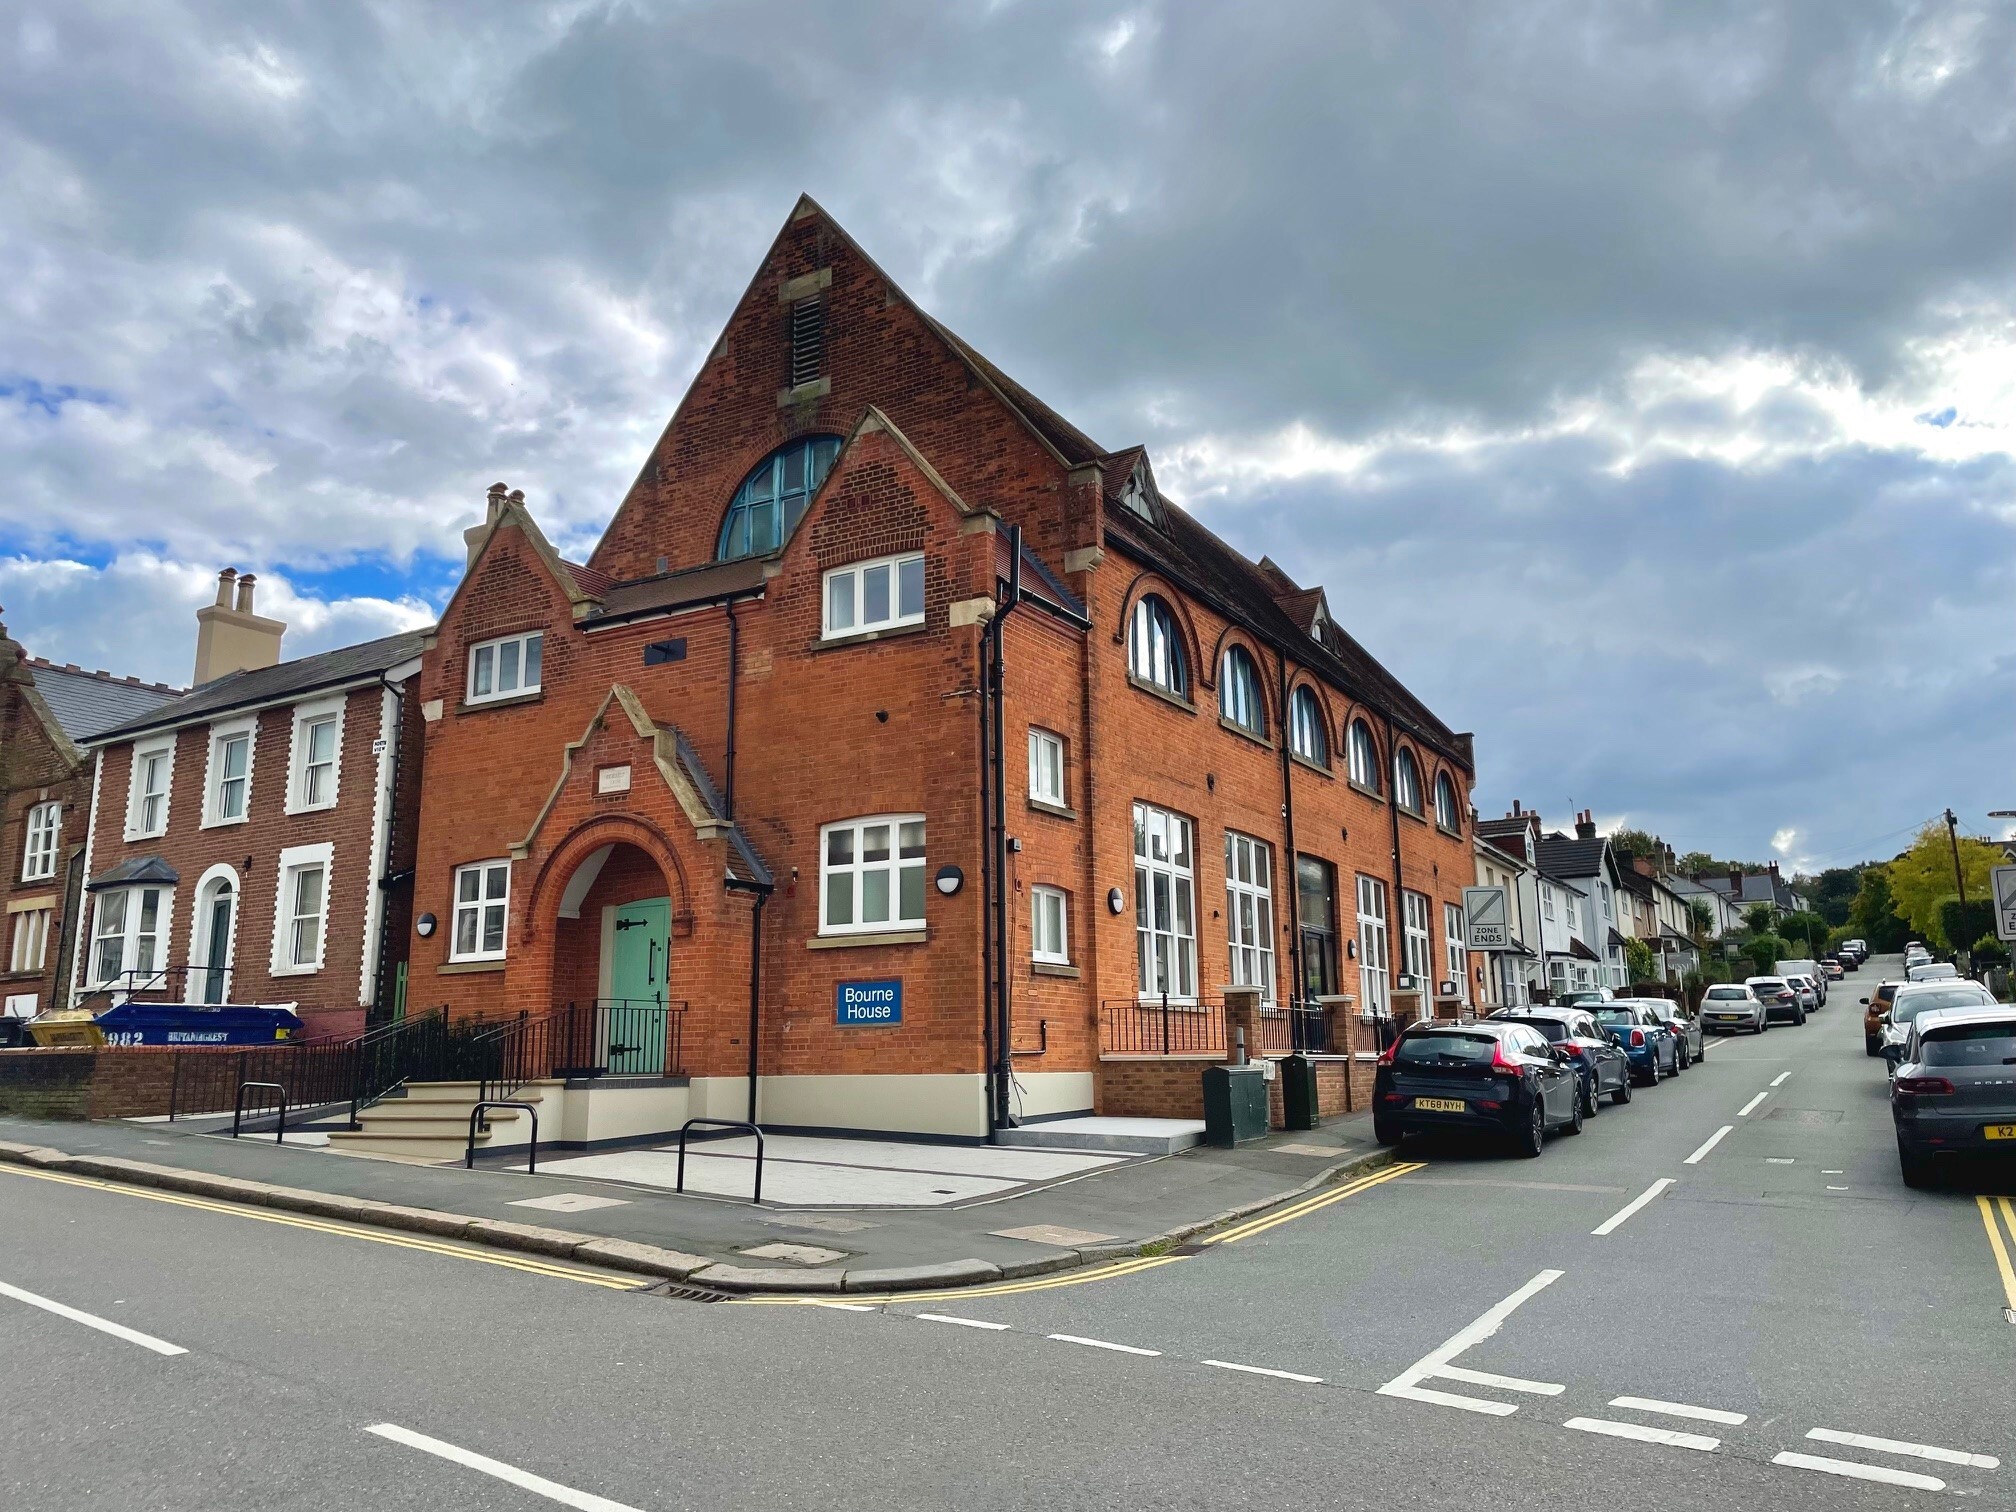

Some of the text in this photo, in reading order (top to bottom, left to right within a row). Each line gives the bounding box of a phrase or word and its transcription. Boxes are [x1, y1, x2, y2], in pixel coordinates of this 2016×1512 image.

[1474, 934, 1502, 943] ENDS
[845, 988, 894, 1003] Bourne
[847, 1004, 891, 1019] House
[102, 1032, 144, 1046] 982
[1419, 1099, 1462, 1110] KT68 NYH
